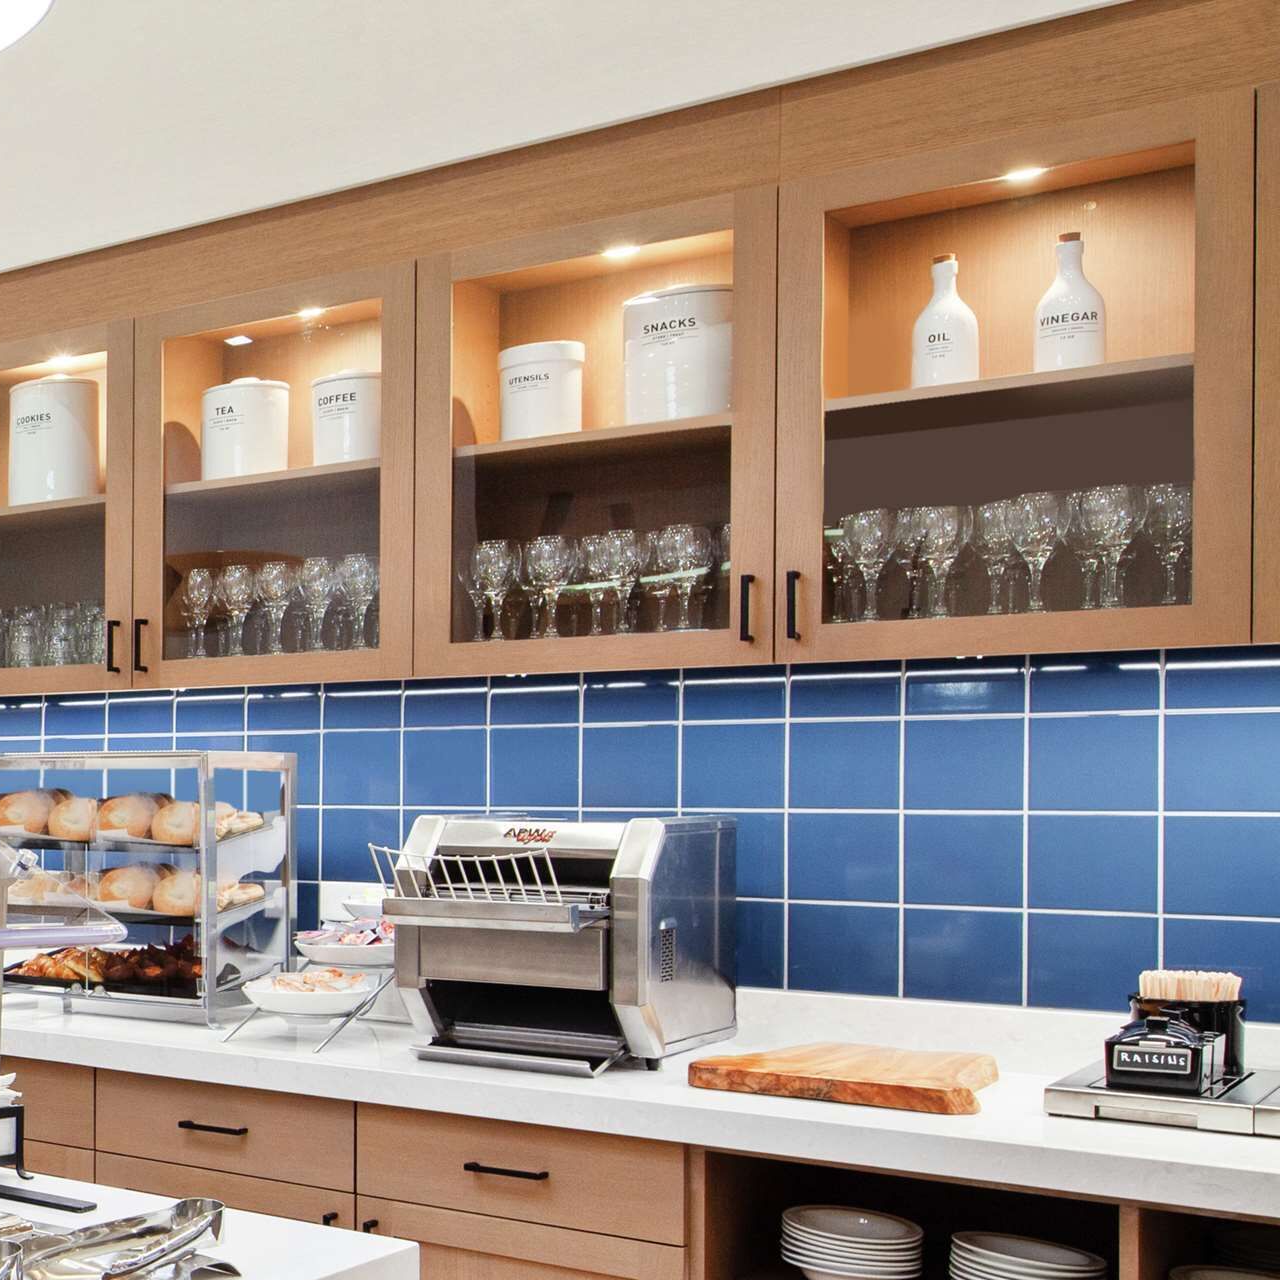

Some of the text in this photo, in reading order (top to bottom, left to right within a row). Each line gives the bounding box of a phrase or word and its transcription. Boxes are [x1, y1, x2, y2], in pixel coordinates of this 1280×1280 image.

[643, 317, 696, 335] SNACKS
[1040, 311, 1098, 327] VINEGAR
[928, 332, 950, 343] OIL
[508, 373, 550, 386] UTENSILS
[317, 391, 357, 407] COFFEE
[215, 405, 234, 416] TEA
[16, 412, 52, 426] COOKIES
[1120, 1052, 1186, 1066] RAISINS
